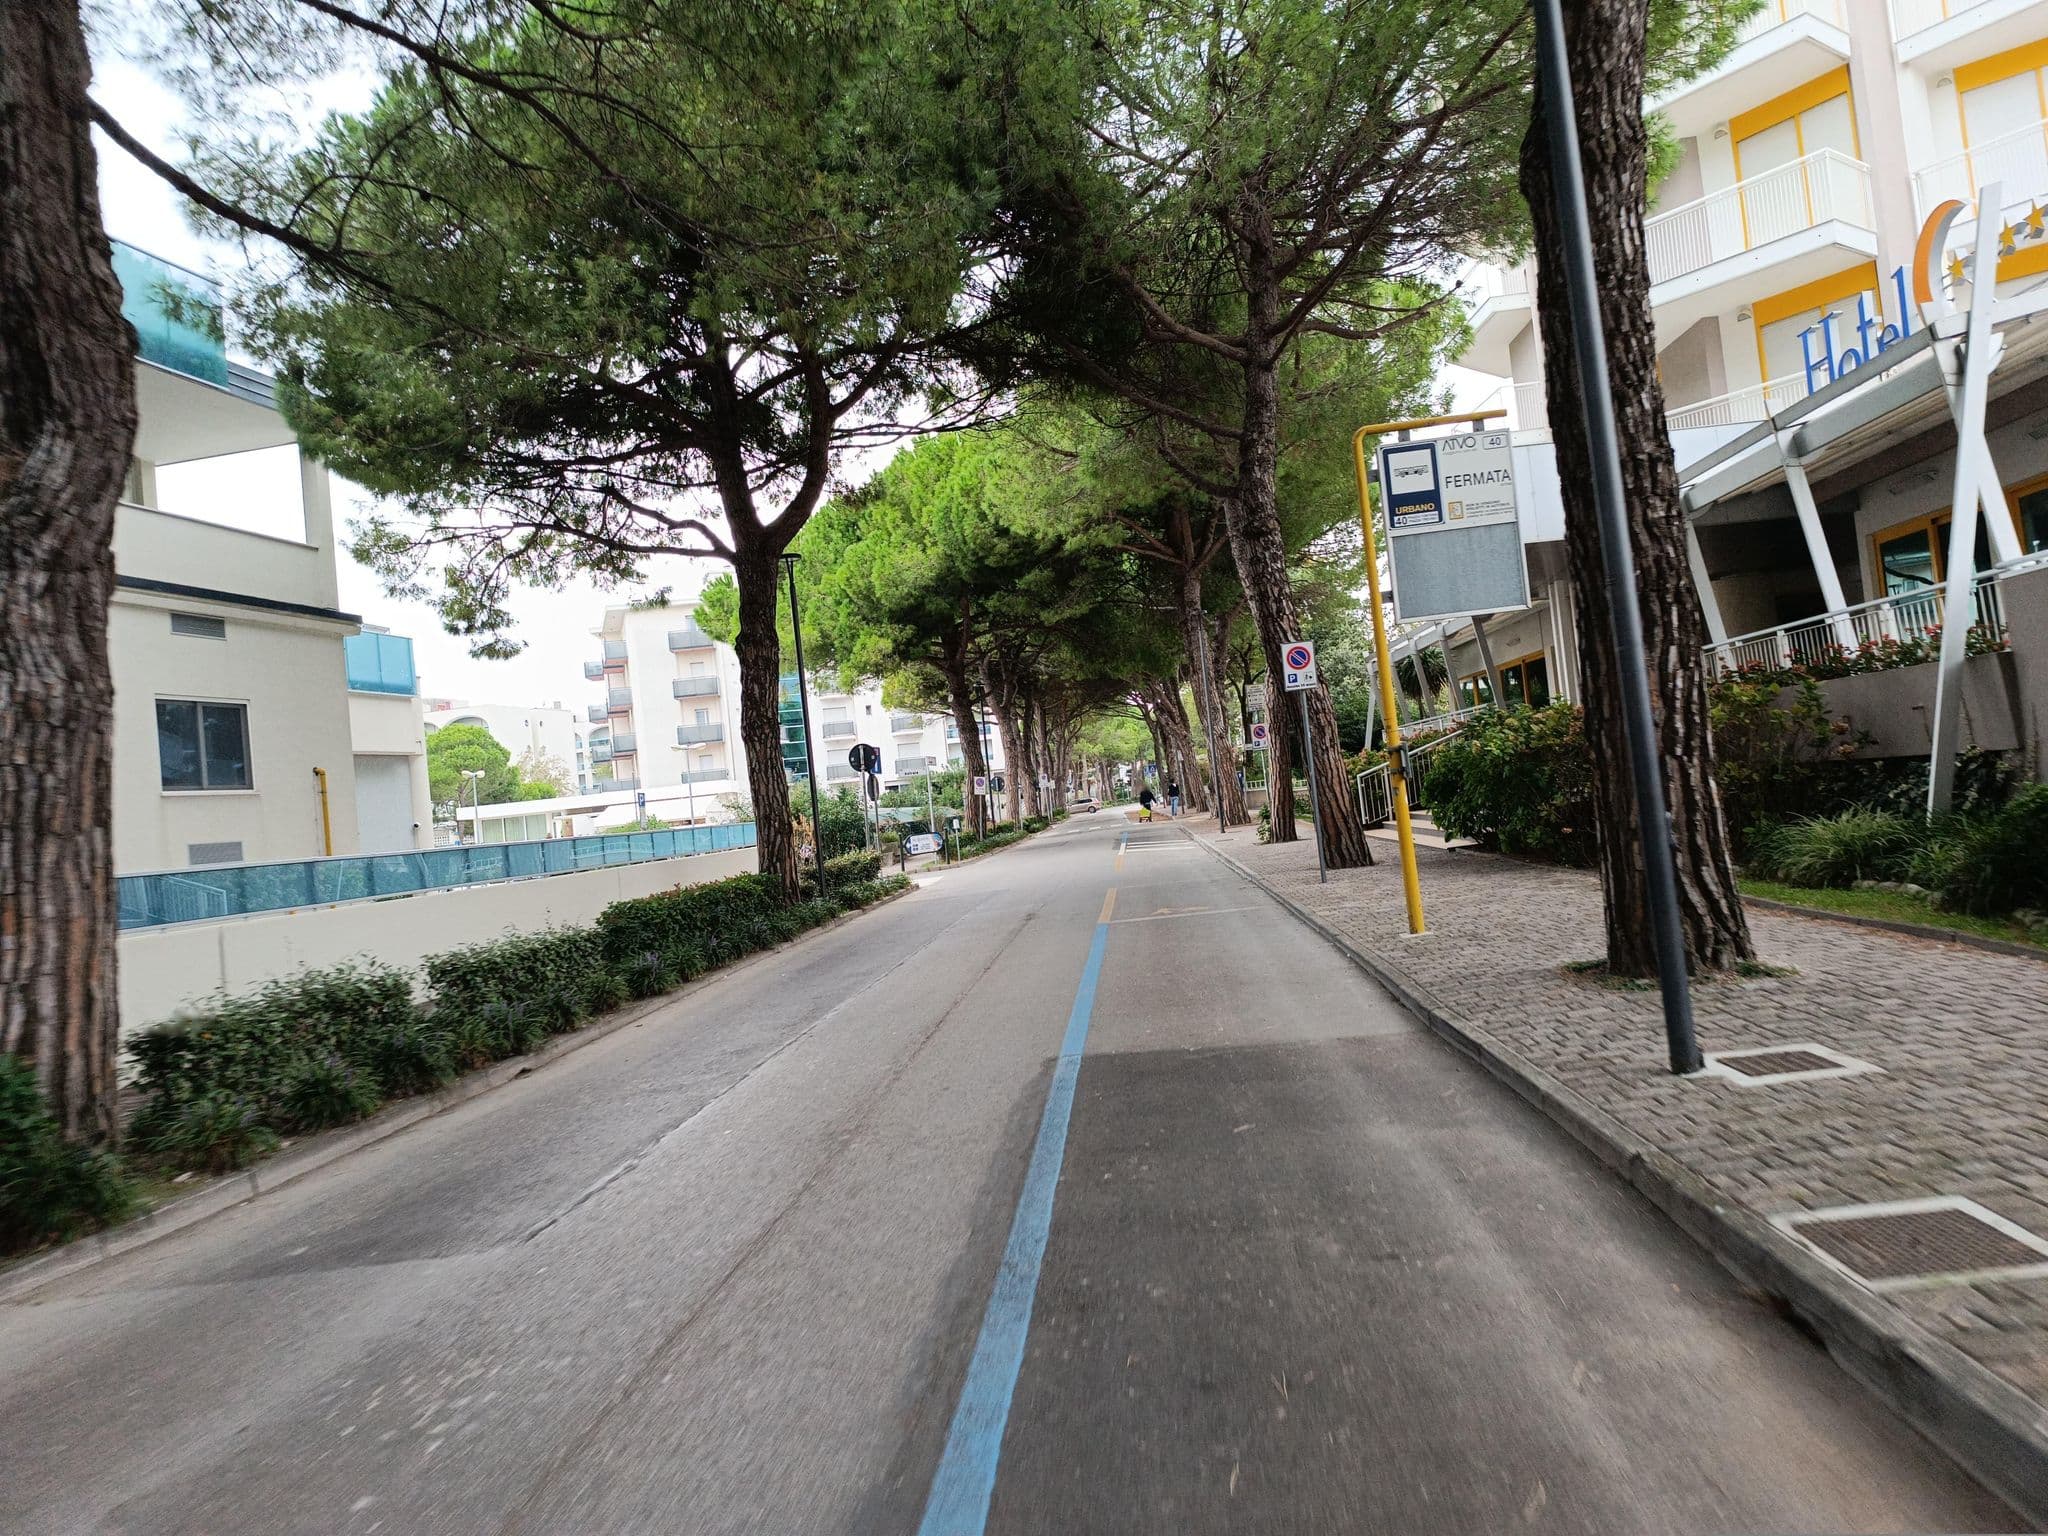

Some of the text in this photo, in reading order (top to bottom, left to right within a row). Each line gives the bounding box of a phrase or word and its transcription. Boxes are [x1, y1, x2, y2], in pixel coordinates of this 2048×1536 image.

[1797, 265, 1910, 397] Hotel
[1442, 436, 1477, 452] ATVO
[1489, 437, 1501, 446] 40
[1445, 469, 1512, 489] FERMATA
[1395, 503, 1434, 514] URBANO
[1395, 516, 1408, 525] 40
